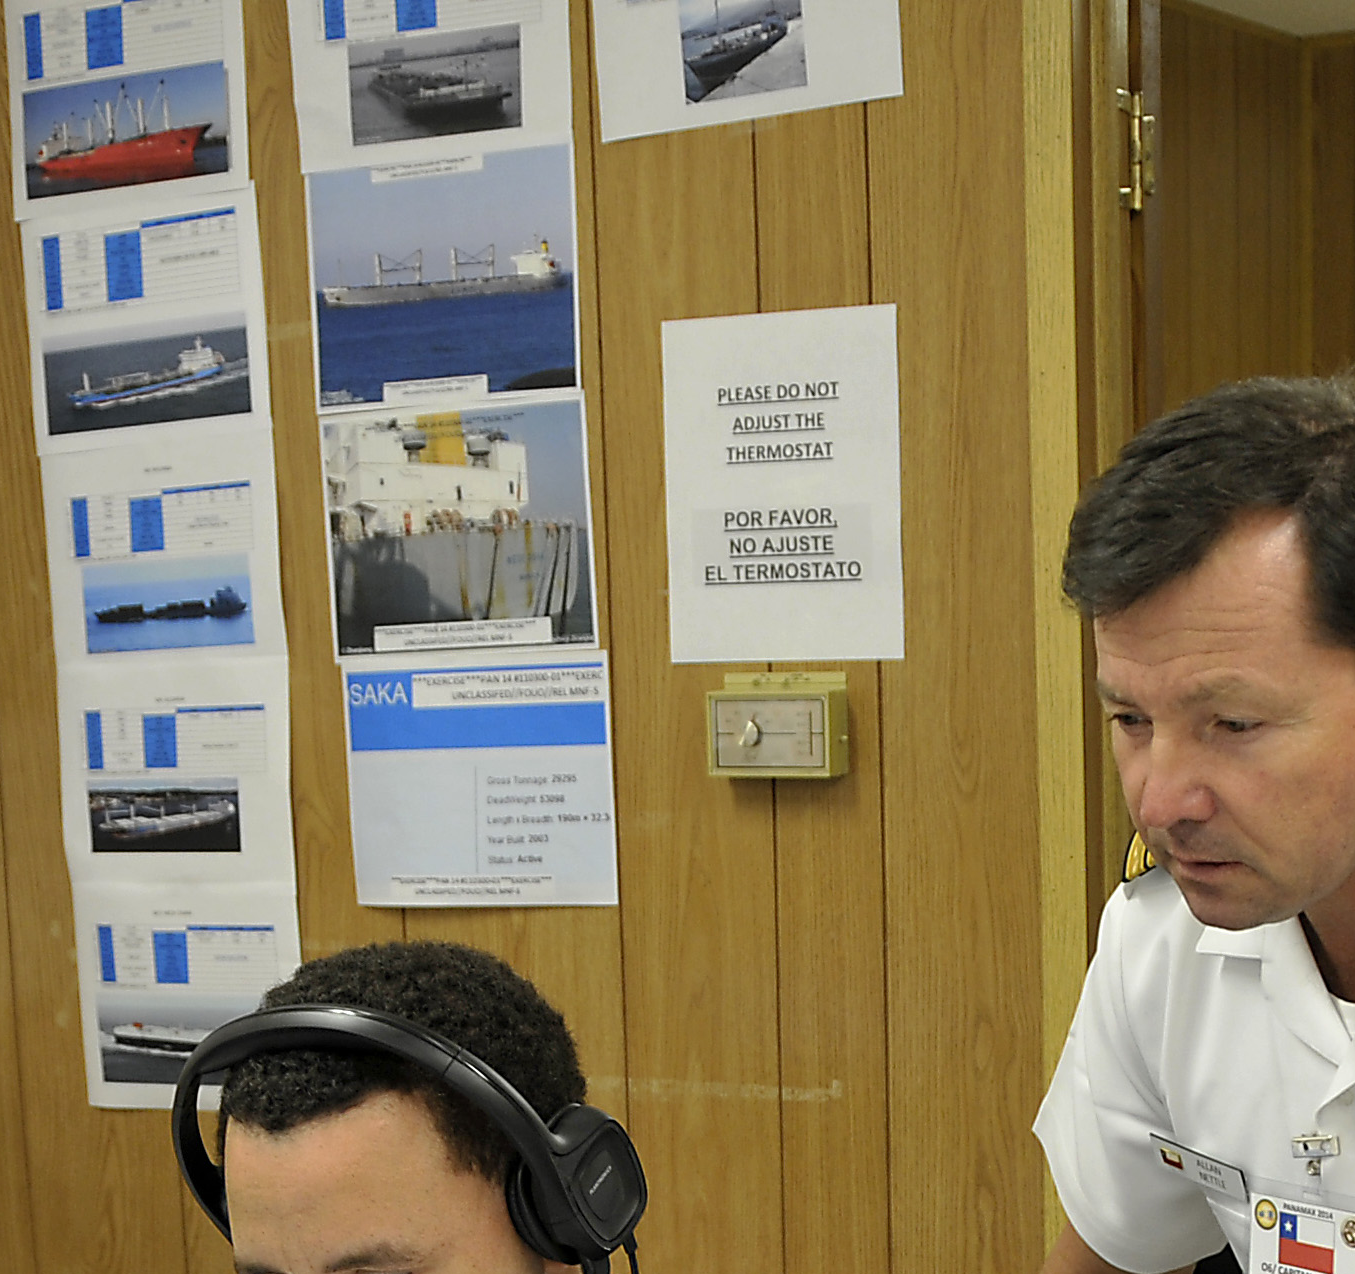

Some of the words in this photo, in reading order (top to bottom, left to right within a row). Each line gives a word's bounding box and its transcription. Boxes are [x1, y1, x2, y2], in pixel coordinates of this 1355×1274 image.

[718, 383, 772, 403] PLEASE
[777, 382, 799, 401] DO
[805, 381, 838, 399] NOT
[733, 413, 791, 432] ADJUST
[795, 411, 825, 430] THE
[726, 441, 833, 462] THERMOSTAT
[724, 510, 763, 529] POR
[768, 509, 836, 529] FAVOR,
[730, 536, 756, 555] NO
[762, 534, 833, 554] AJUSTE
[705, 564, 728, 581] EL
[733, 561, 862, 581] TERMOSTATO
[350, 682, 408, 704] SAKA
[517, 855, 543, 863] Active
[1196, 1158, 1222, 1176] ALLAN
[1199, 1171, 1226, 1189] NETTLE
[1283, 1202, 1316, 1218] PANAMAX
[1317, 1209, 1334, 1220] 2014
